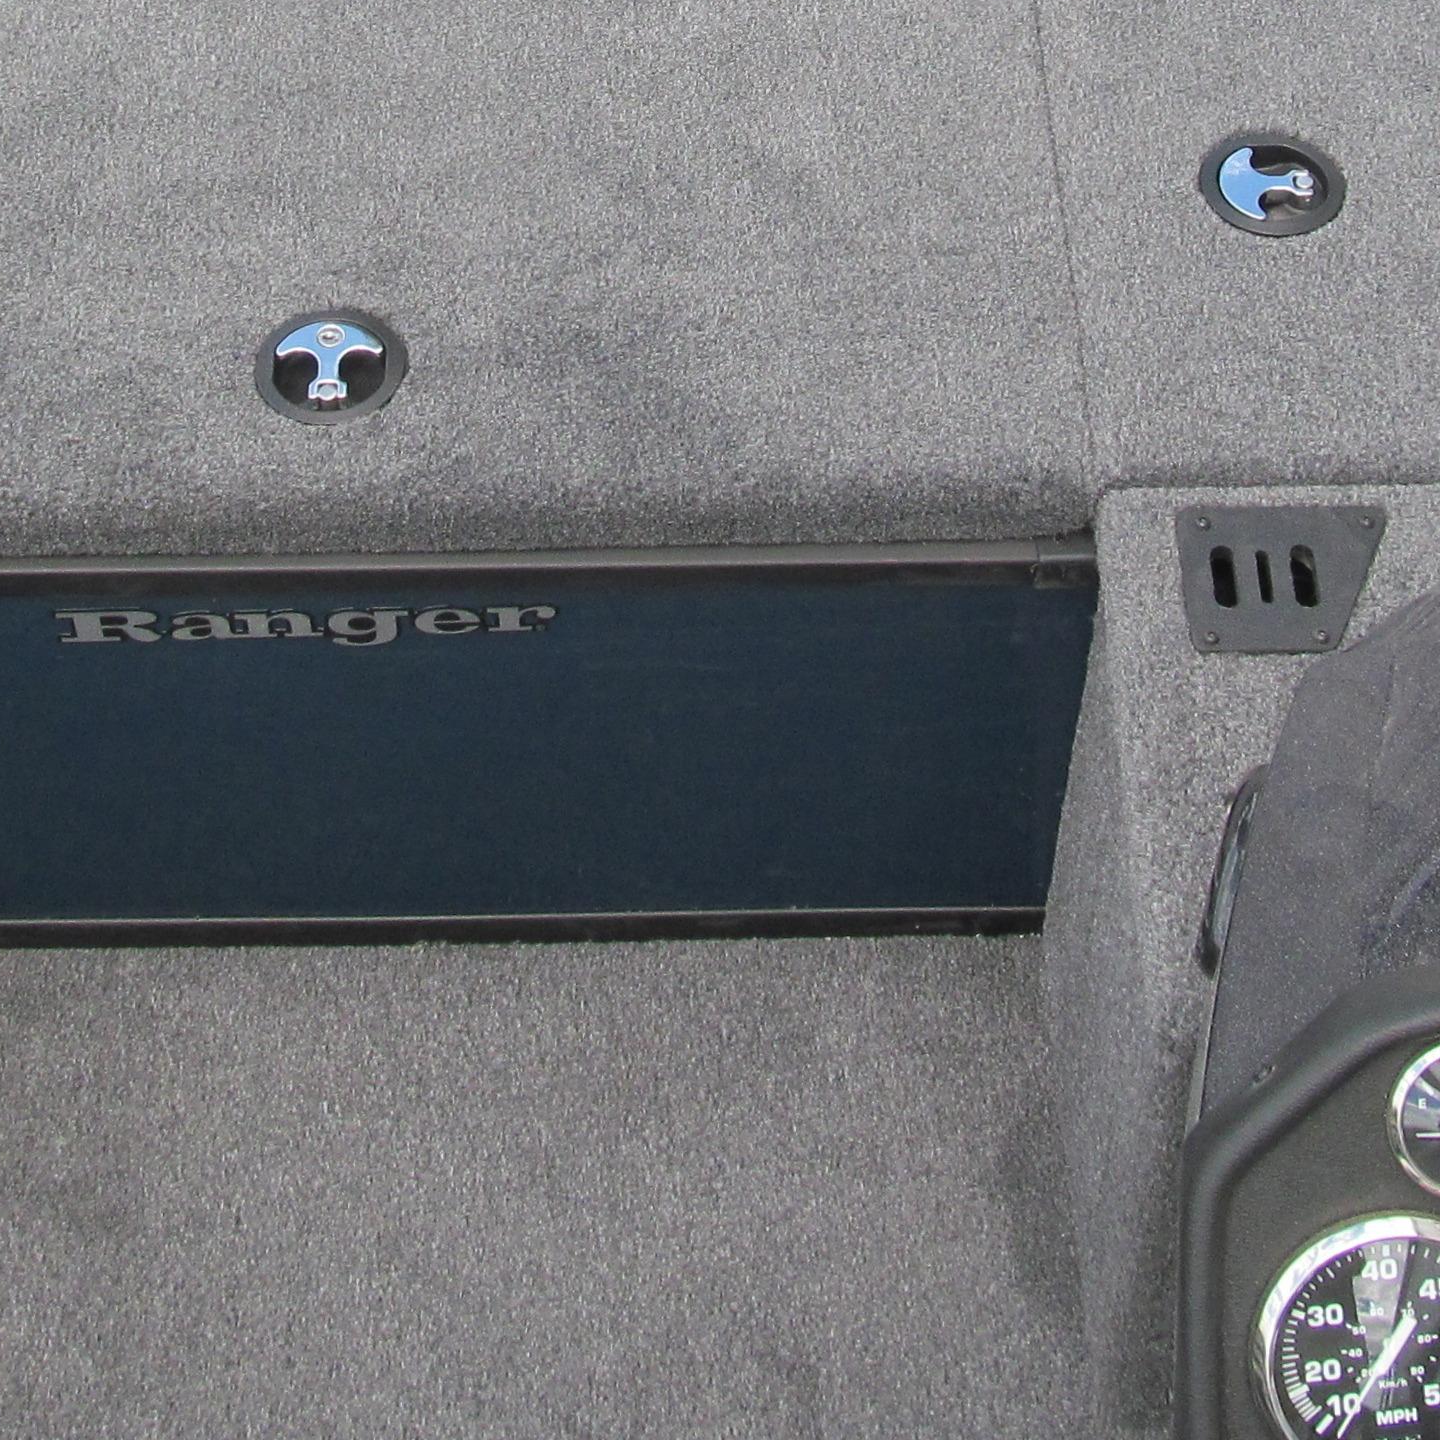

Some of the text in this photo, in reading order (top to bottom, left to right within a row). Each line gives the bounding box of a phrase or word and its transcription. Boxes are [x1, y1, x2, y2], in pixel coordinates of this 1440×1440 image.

[54, 603, 557, 646] Ranger
[1418, 1098, 1427, 1109] E
[1361, 1258, 1398, 1281] 40
[1307, 1303, 1344, 1326] 30
[1304, 1358, 1342, 1382] 20
[1326, 1392, 1361, 1417] 10
[1375, 1407, 1418, 1427] MPH
